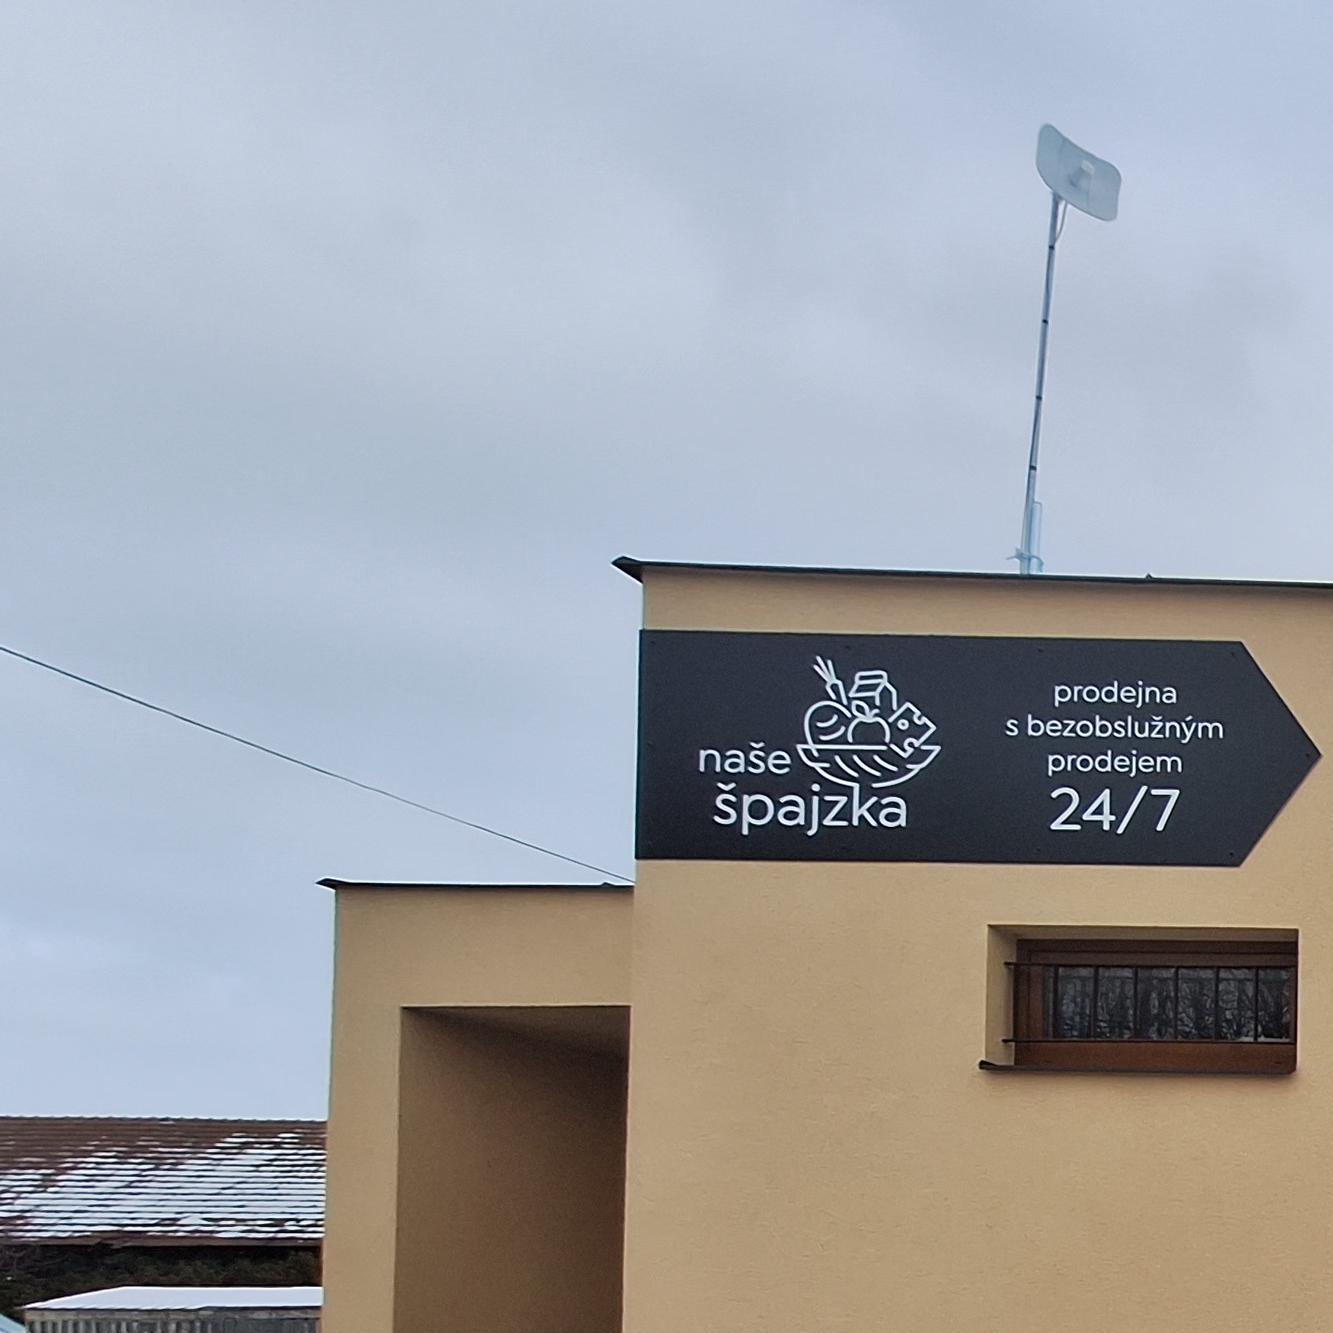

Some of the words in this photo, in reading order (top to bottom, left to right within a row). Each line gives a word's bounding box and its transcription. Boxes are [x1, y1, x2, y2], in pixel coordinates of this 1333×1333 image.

[1054, 680, 1178, 708] prodejna
[1005, 719, 1019, 736] s
[1027, 713, 1224, 744] bezobslužným
[699, 740, 792, 775] naše
[1047, 749, 1182, 778] prodejem
[713, 784, 908, 836] špajzka
[1049, 786, 1181, 834] 24/7
